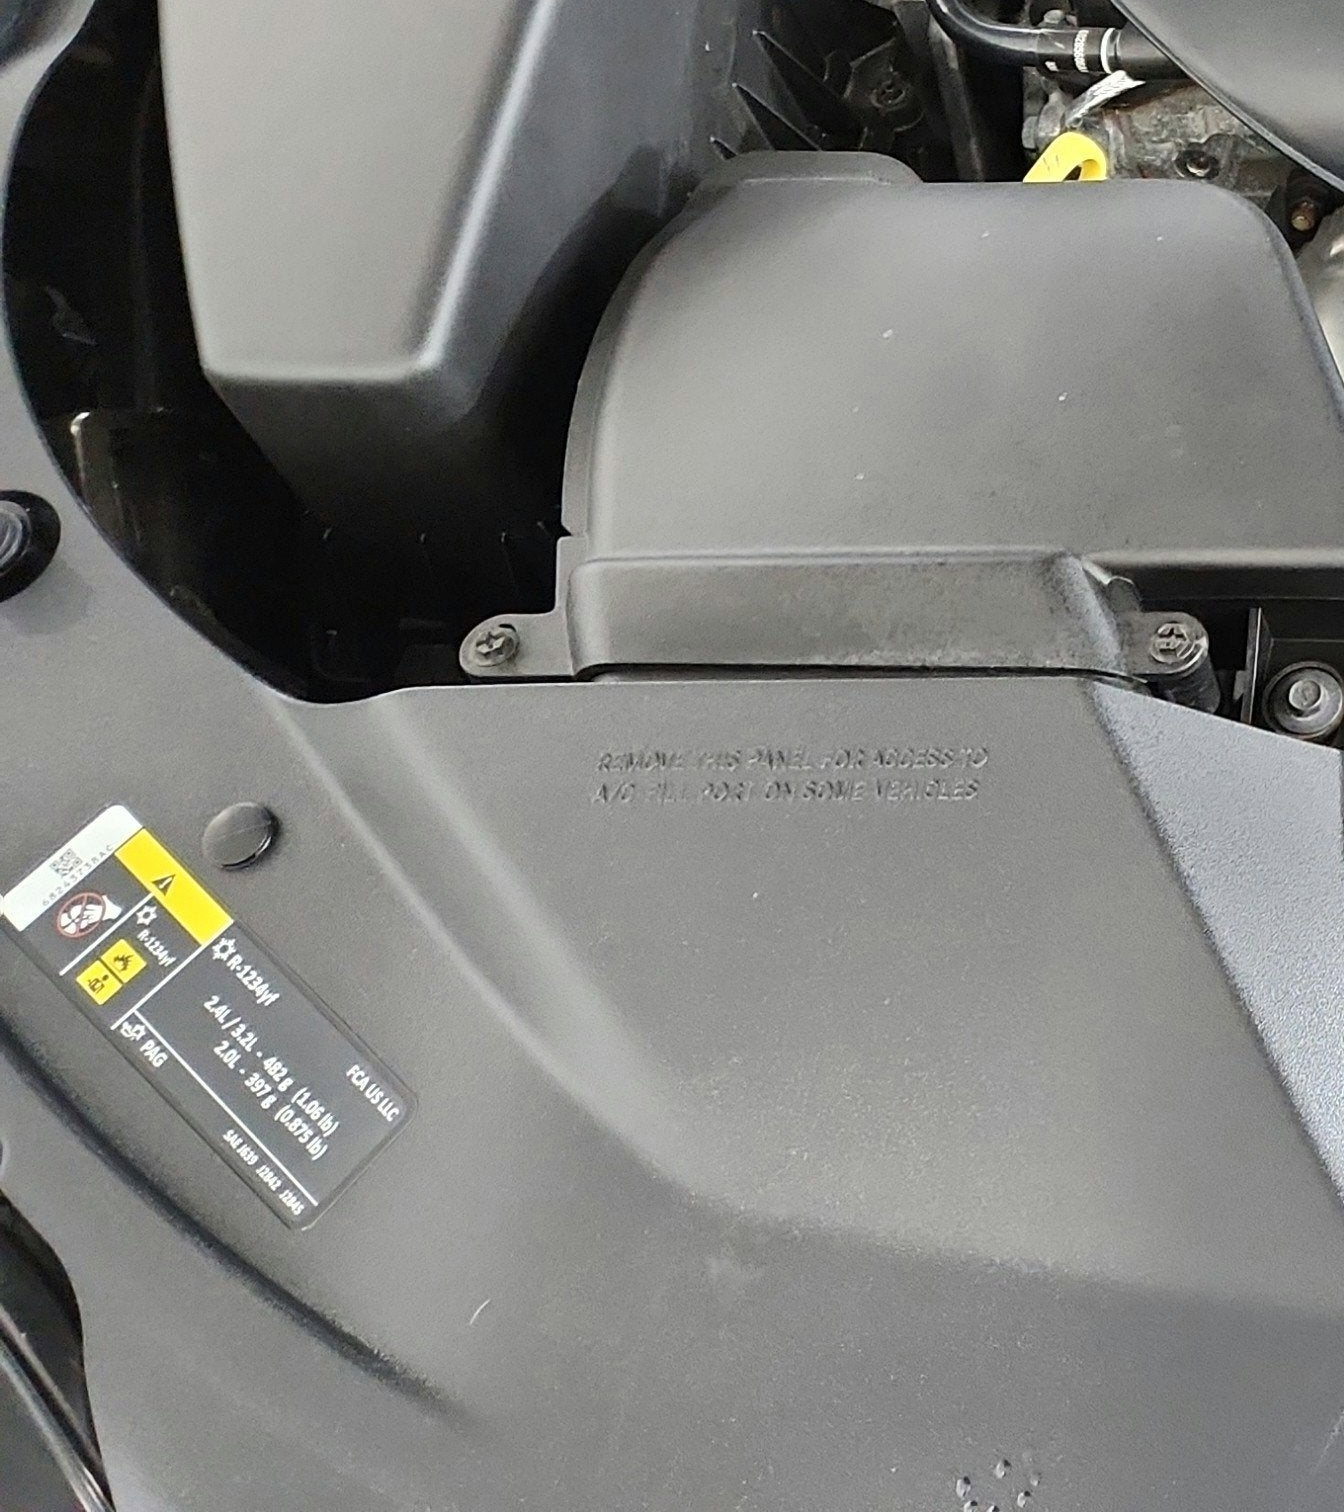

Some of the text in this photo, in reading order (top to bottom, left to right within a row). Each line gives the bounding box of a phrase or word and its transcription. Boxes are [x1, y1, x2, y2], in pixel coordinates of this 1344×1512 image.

[819, 748, 864, 769] FOR
[873, 747, 954, 769] ACCESS
[803, 779, 867, 800] SOME
[875, 777, 979, 800] VEHICLES
[226, 953, 280, 1007] R-1234yf
[139, 1039, 169, 1068] PAG
[203, 995, 233, 1024] 2.4L
[230, 1023, 260, 1052] 3.2L
[262, 1056, 289, 1082] 482
[277, 1077, 295, 1092] g
[290, 1086, 326, 1122] (1.06
[317, 1112, 340, 1138] lb)
[213, 1039, 242, 1069] 2.0L
[244, 1072, 273, 1098] 397
[260, 1094, 278, 1109] g
[273, 1103, 315, 1144] (0.875
[305, 1136, 329, 1161] lb)
[345, 1064, 400, 1122] FCA US LLC
[222, 1128, 244, 1149] SAE
[235, 1143, 260, 1166] J639
[255, 1164, 282, 1192] J2842
